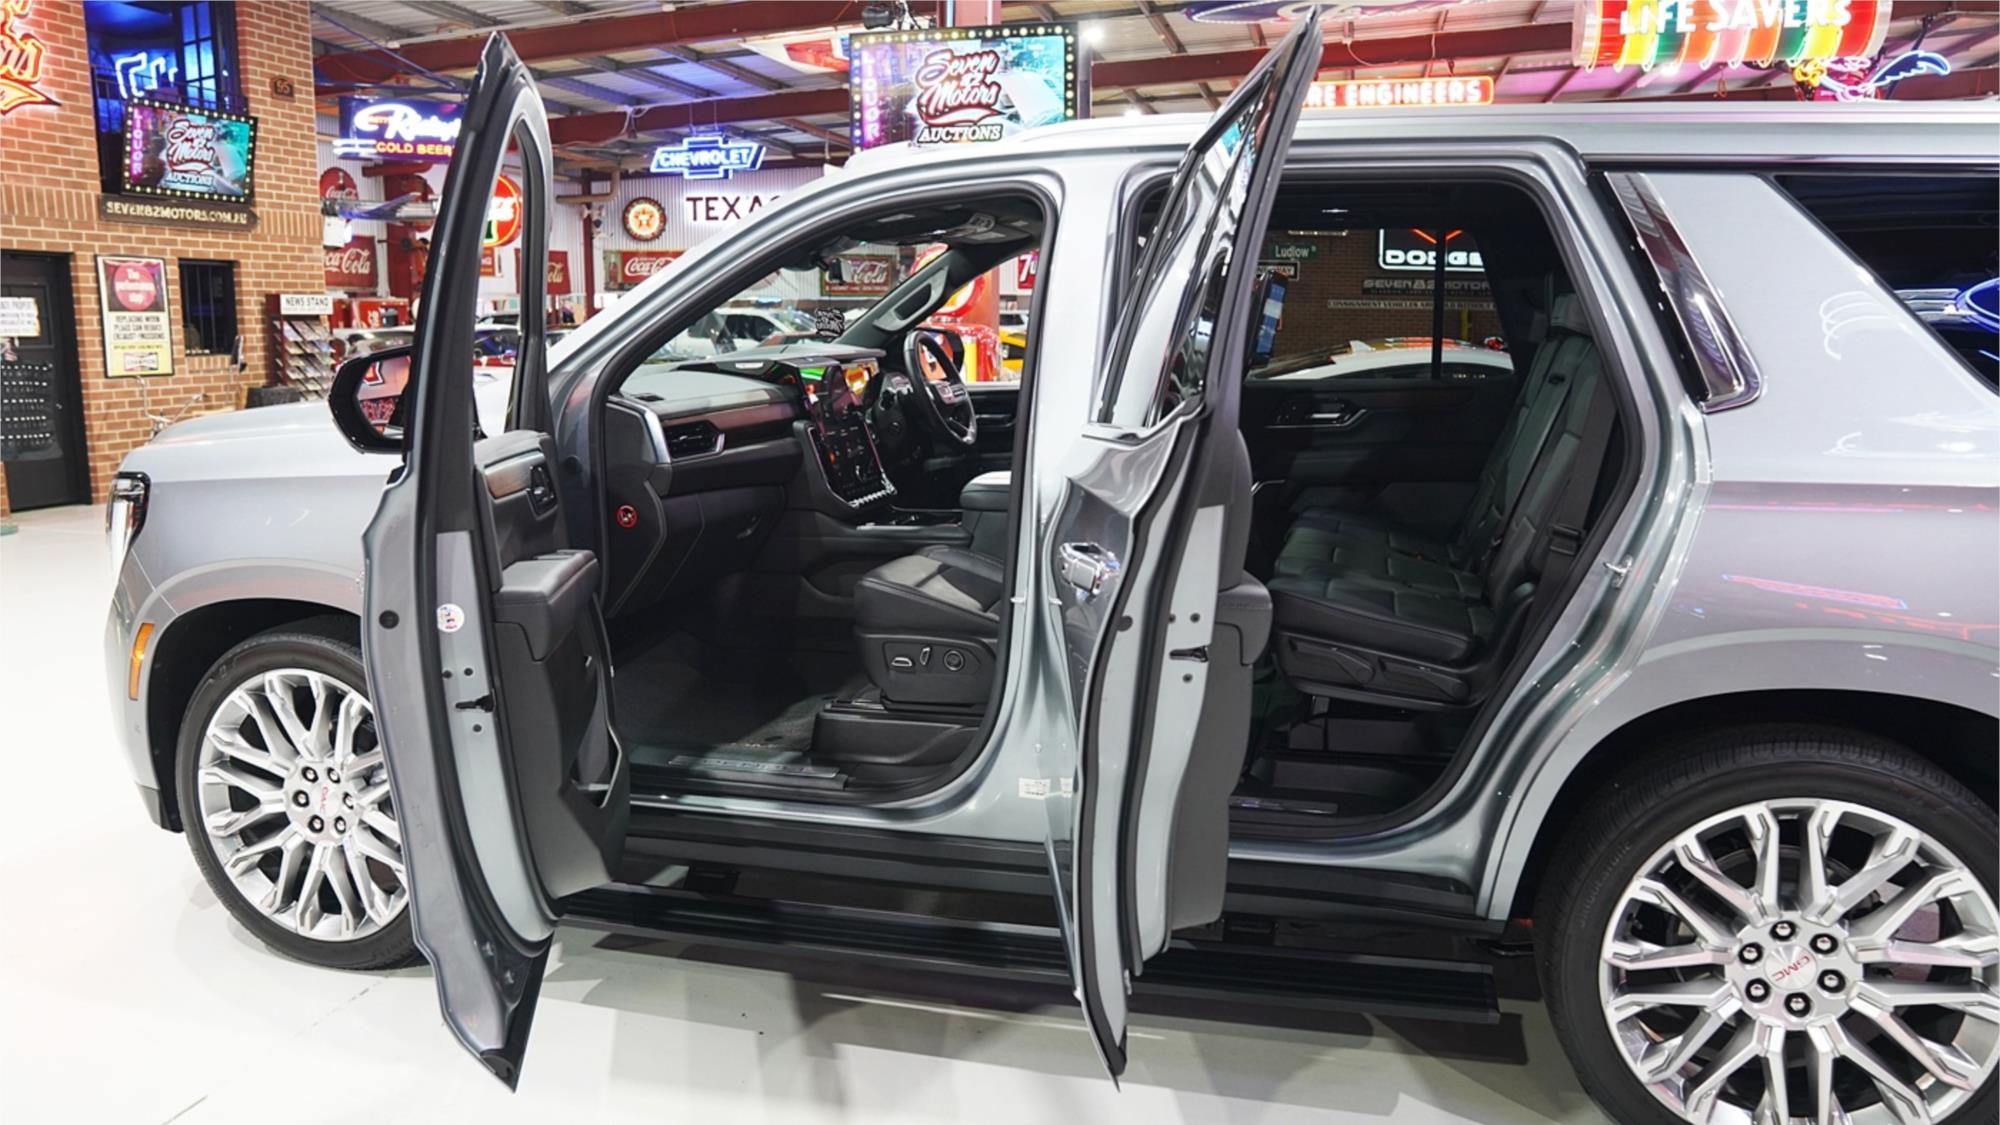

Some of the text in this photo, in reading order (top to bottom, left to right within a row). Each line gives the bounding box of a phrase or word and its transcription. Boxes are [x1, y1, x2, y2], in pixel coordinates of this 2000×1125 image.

[1619, 0, 1852, 34] LIFE SAVERS
[920, 50, 994, 82] Seven
[861, 50, 881, 141] LIQUOR
[920, 83, 1000, 114] Motors
[1345, 79, 1482, 105] ENGINEERS
[131, 107, 144, 175] LIQUOR
[376, 141, 414, 154] COLD
[919, 126, 1002, 143] AUCTIONS
[659, 149, 750, 168] CHEVROLET
[1275, 245, 1310, 258] Ludlow
[284, 297, 329, 307] NEWS STAND
[1772, 955, 1811, 982] GMC
